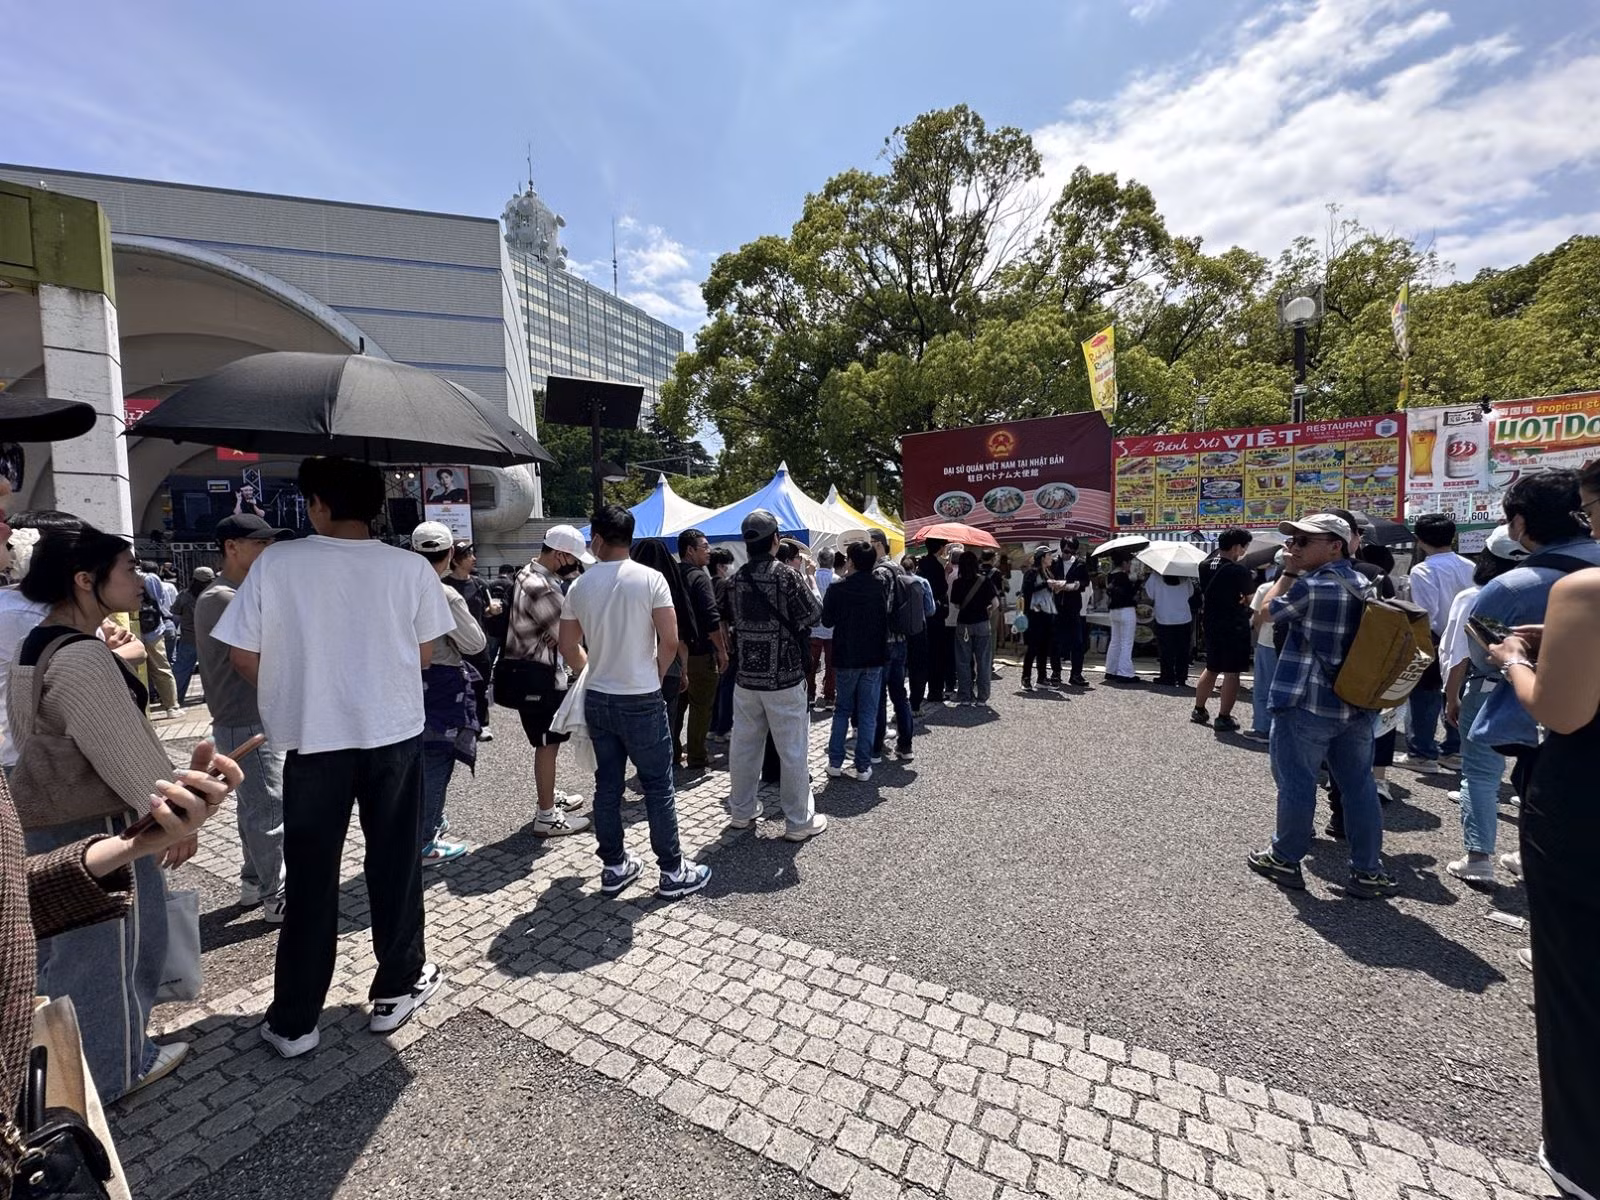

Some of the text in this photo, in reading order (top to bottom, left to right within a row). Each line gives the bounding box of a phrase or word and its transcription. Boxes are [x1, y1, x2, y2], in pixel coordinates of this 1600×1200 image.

[1536, 400, 1582, 413] tropical
[1306, 419, 1374, 433] RESTAURANT
[1496, 415, 1561, 444] HOT
[1222, 429, 1301, 449] VIỆT
[985, 461, 999, 472] VIỆT
[1000, 460, 1016, 469] NAM
[1017, 459, 1028, 469] TẠI
[1471, 511, 1489, 520] 600
